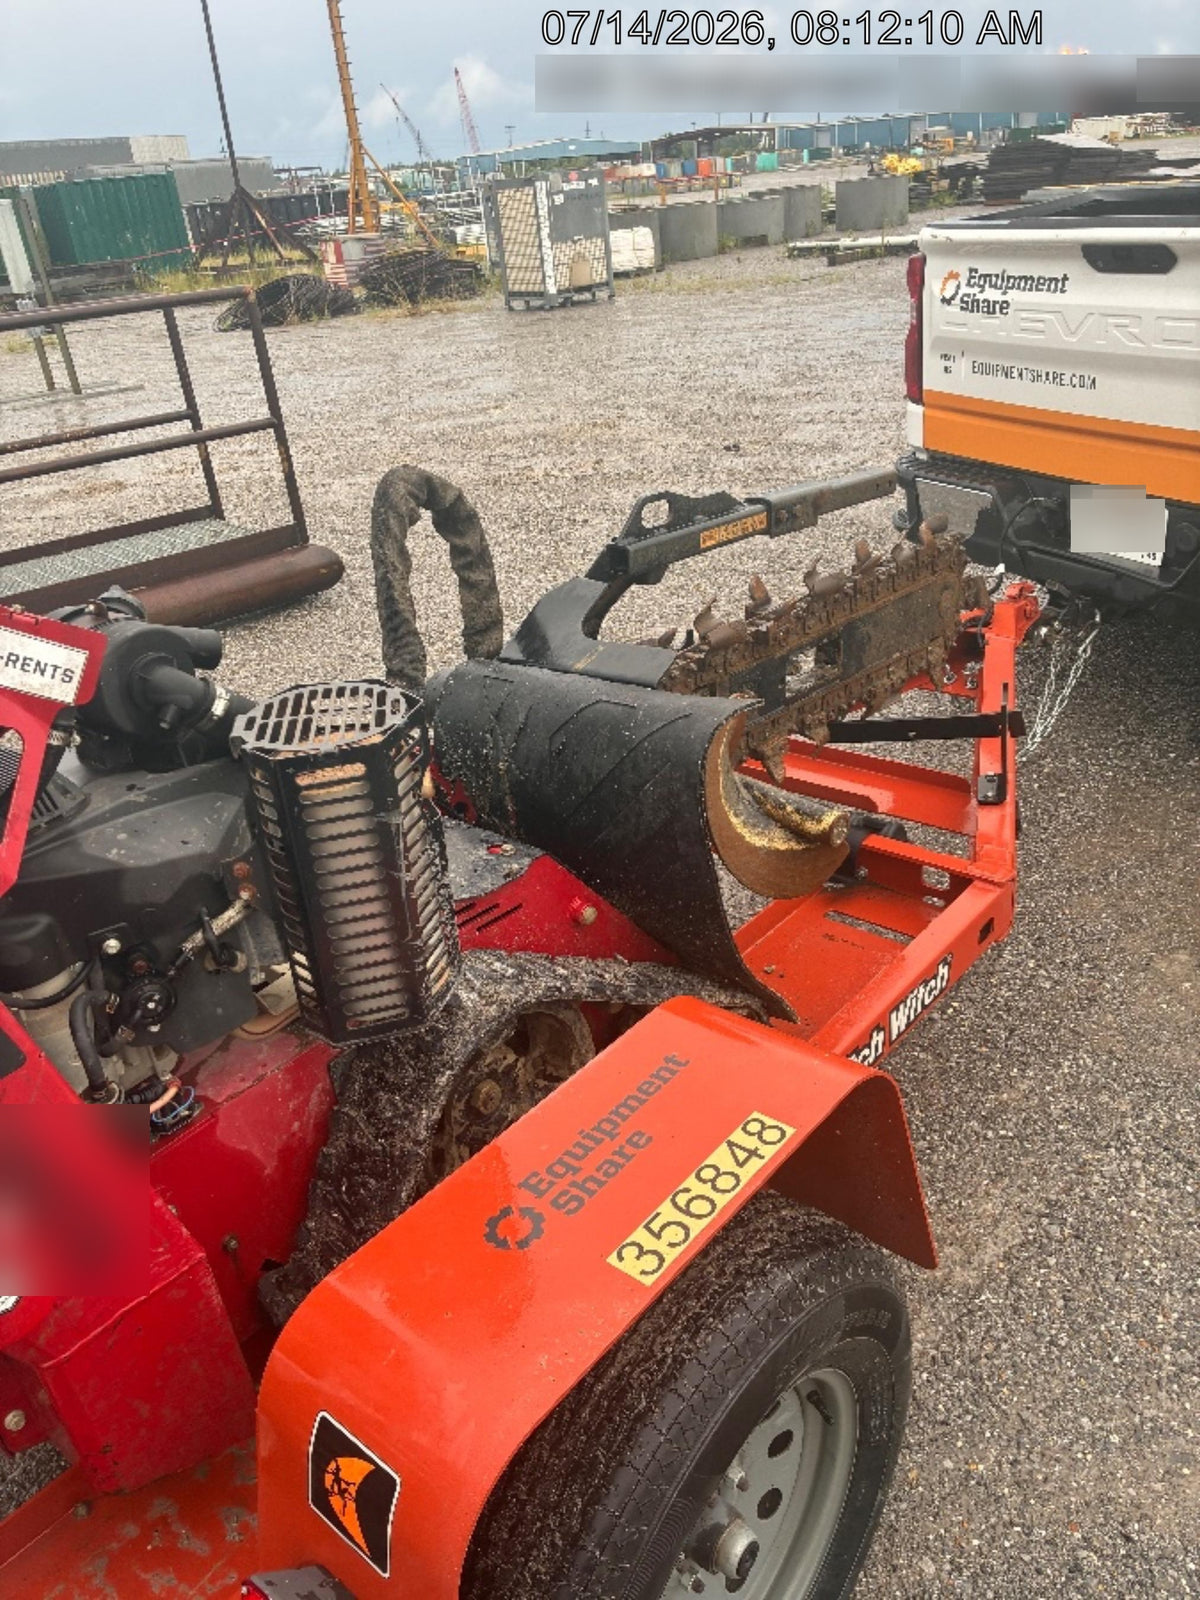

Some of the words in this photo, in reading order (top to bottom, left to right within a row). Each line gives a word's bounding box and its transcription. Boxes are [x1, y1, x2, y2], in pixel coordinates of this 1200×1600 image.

[959, 292, 1011, 316] Share
[965, 266, 1070, 296] Equipment
[972, 360, 1097, 390] EQUIPMENTSHARE.COM
[889, 957, 952, 1046] Witch
[517, 1051, 690, 1200] Equipment
[549, 1127, 654, 1217] Share
[616, 1116, 787, 1277] 356848
